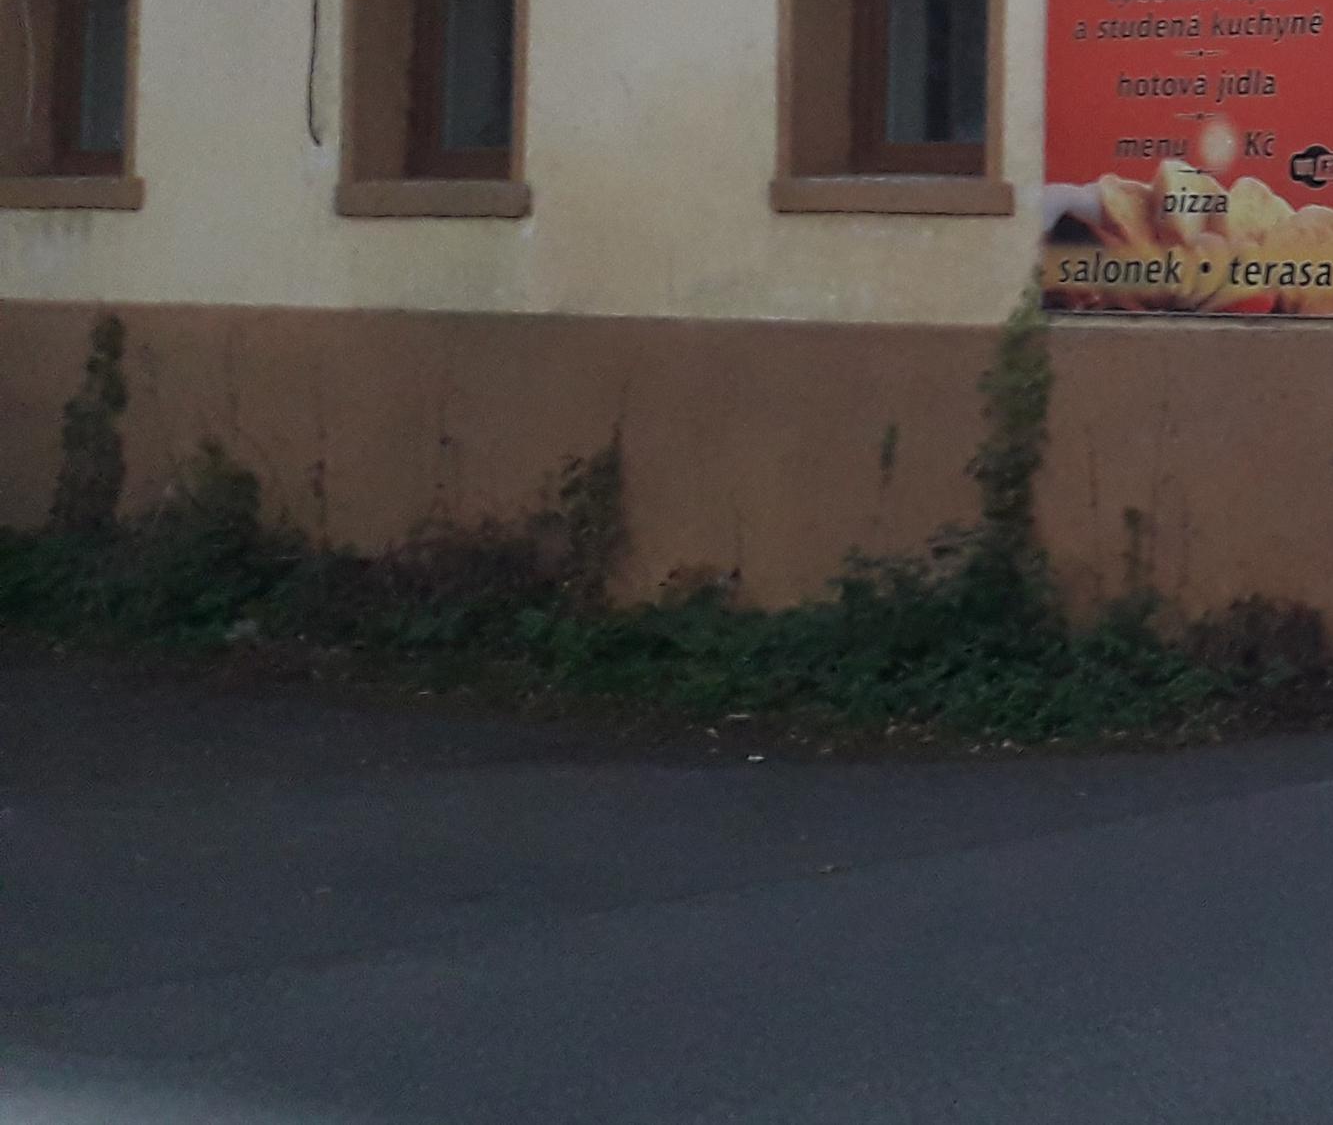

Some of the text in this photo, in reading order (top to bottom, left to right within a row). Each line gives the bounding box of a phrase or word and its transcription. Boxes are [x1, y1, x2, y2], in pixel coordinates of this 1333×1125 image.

[1073, 20, 1088, 40] a
[1115, 137, 1190, 159] menu
[1163, 187, 1230, 216] pizza
[1058, 250, 1333, 288] salonek terasa
